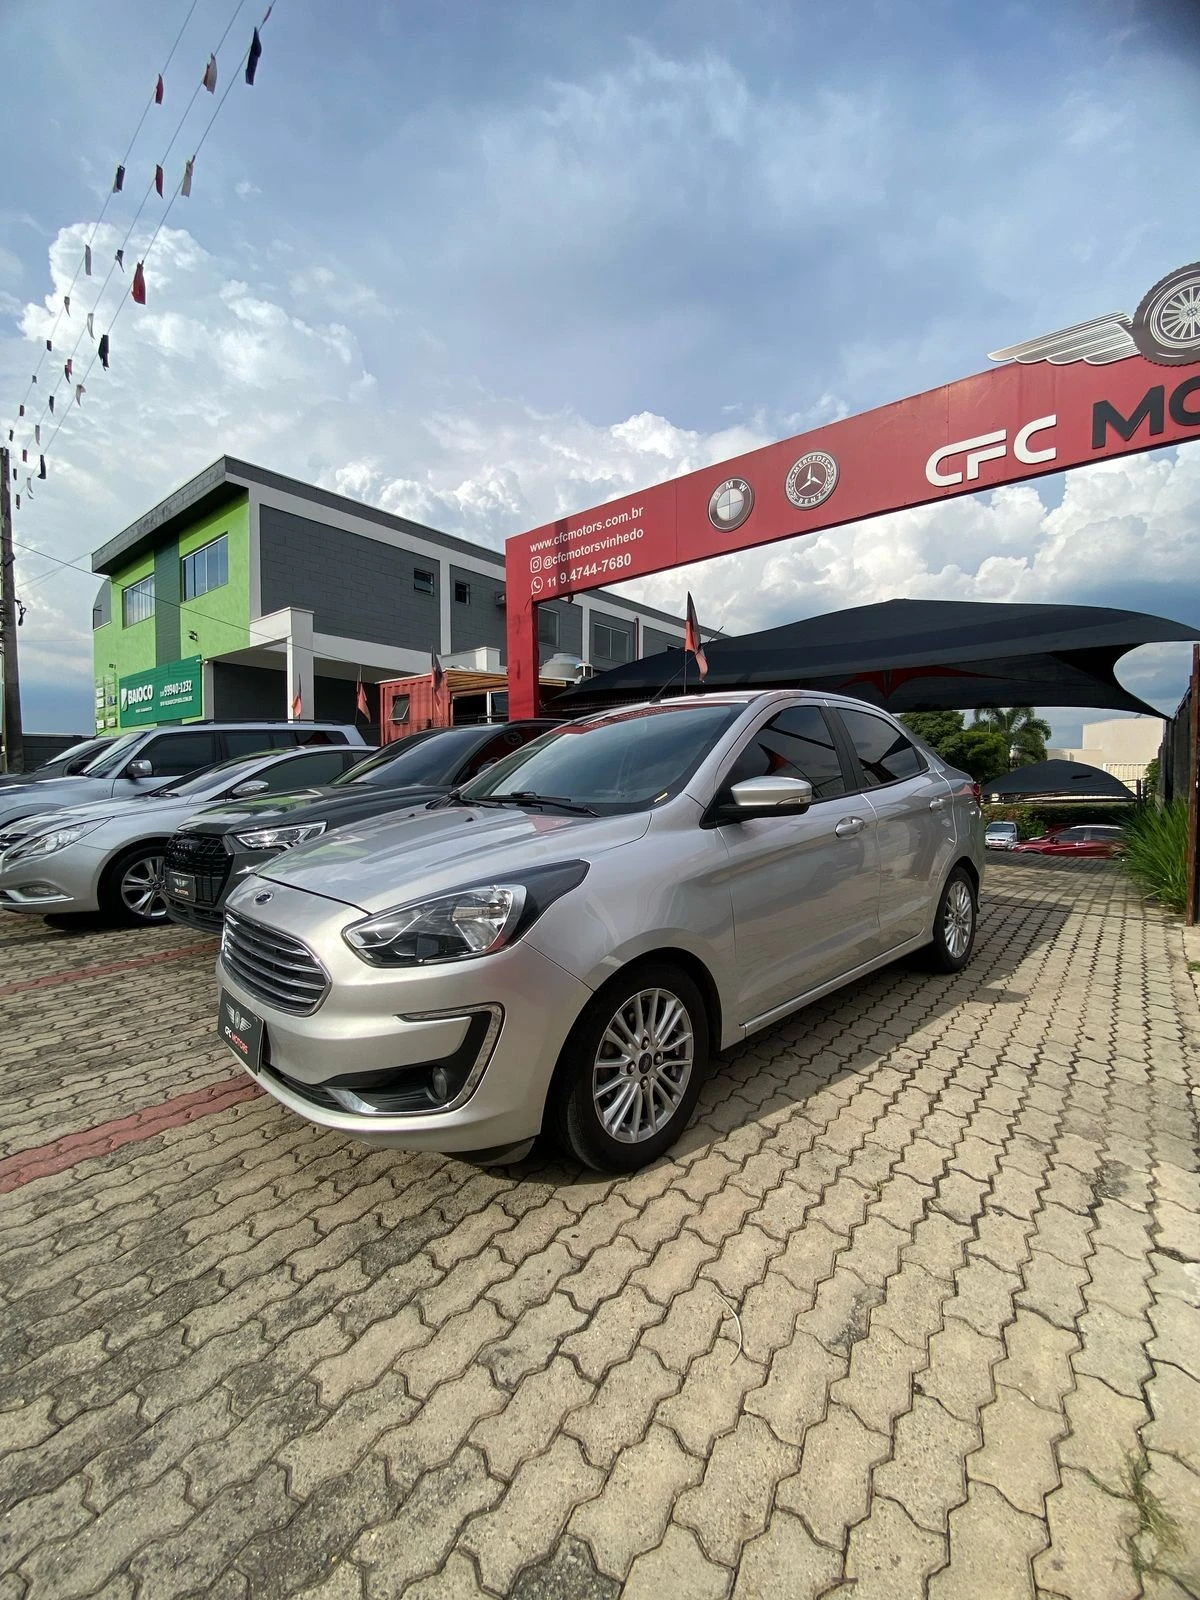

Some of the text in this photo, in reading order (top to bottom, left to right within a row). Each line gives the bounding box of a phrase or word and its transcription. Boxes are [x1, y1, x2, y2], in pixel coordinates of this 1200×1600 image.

[793, 455, 830, 474] MERCEDES
[925, 414, 1057, 487] CFC
[714, 480, 748, 500] BMW
[798, 492, 822, 504] BENZ
[530, 506, 644, 553] www.cfcmotors.com.br
[543, 528, 644, 569] @cfcmotorsvinhedo
[547, 553, 632, 588] 11 9.4744-7680
[128, 684, 153, 705] BAIOCO
